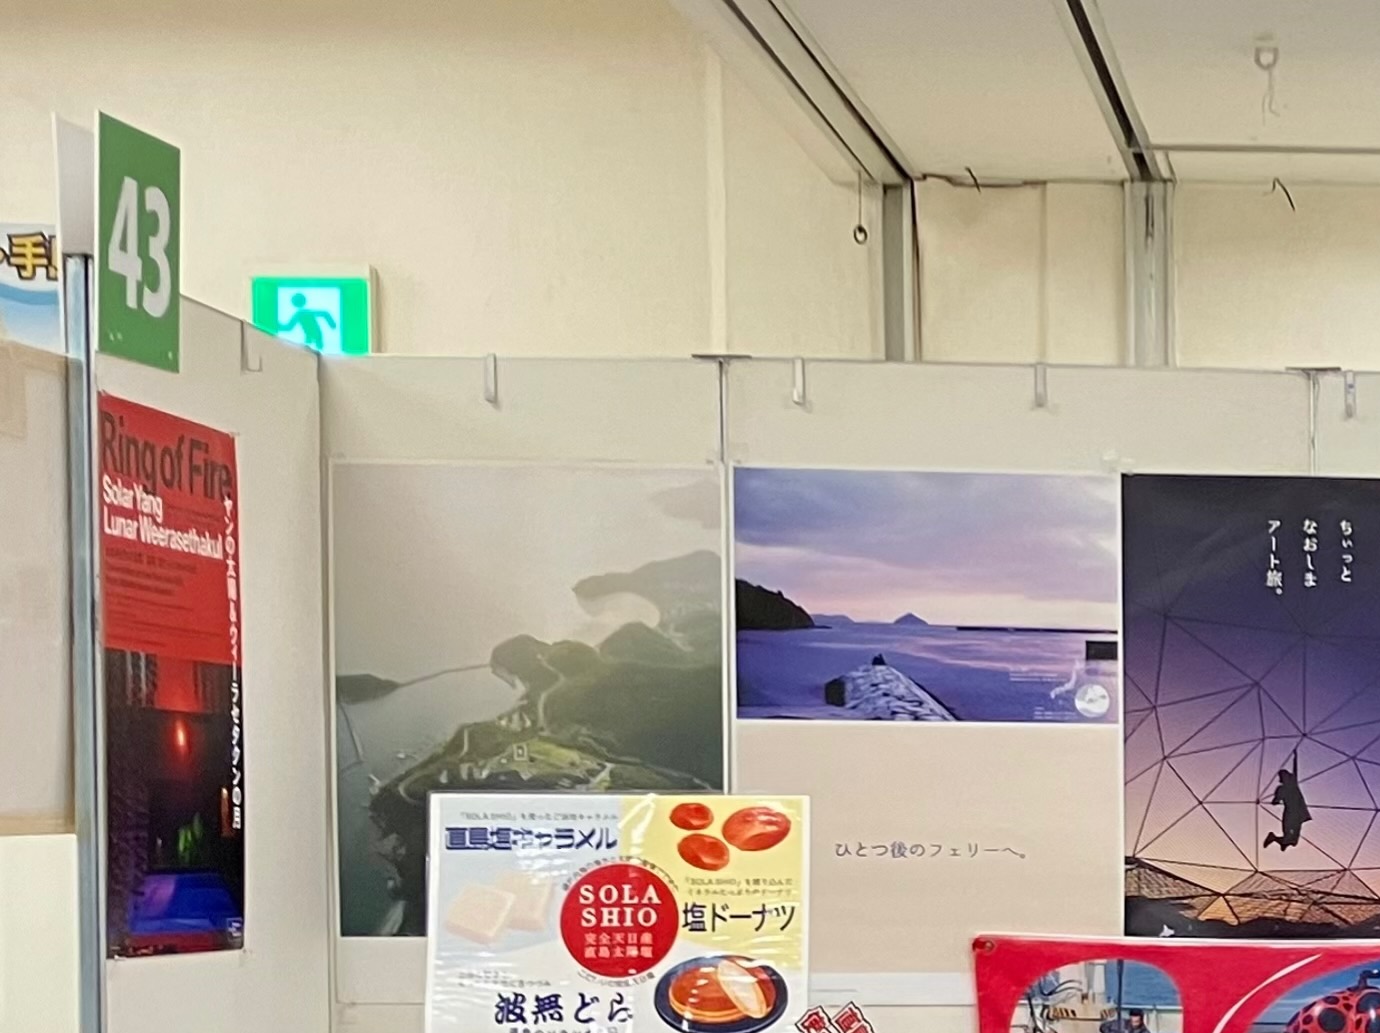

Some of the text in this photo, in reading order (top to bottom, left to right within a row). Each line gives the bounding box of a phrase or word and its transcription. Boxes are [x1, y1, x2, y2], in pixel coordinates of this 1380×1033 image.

[108, 176, 171, 317] 43
[101, 411, 231, 500] Ring of Fire
[103, 475, 133, 510] Solar
[133, 487, 163, 523] Yang
[104, 504, 138, 540] Lunar
[137, 514, 223, 561] Weerasethakul
[1303, 518, 1318, 588] なおしま
[1266, 519, 1283, 595] アート旅。
[835, 840, 1028, 860] ひとつ後のフェリーへ。
[579, 884, 662, 905] SOLA
[581, 906, 658, 927] SHIO
[681, 902, 797, 932] 塩ドーナツ
[495, 992, 633, 1025] 波無どら
